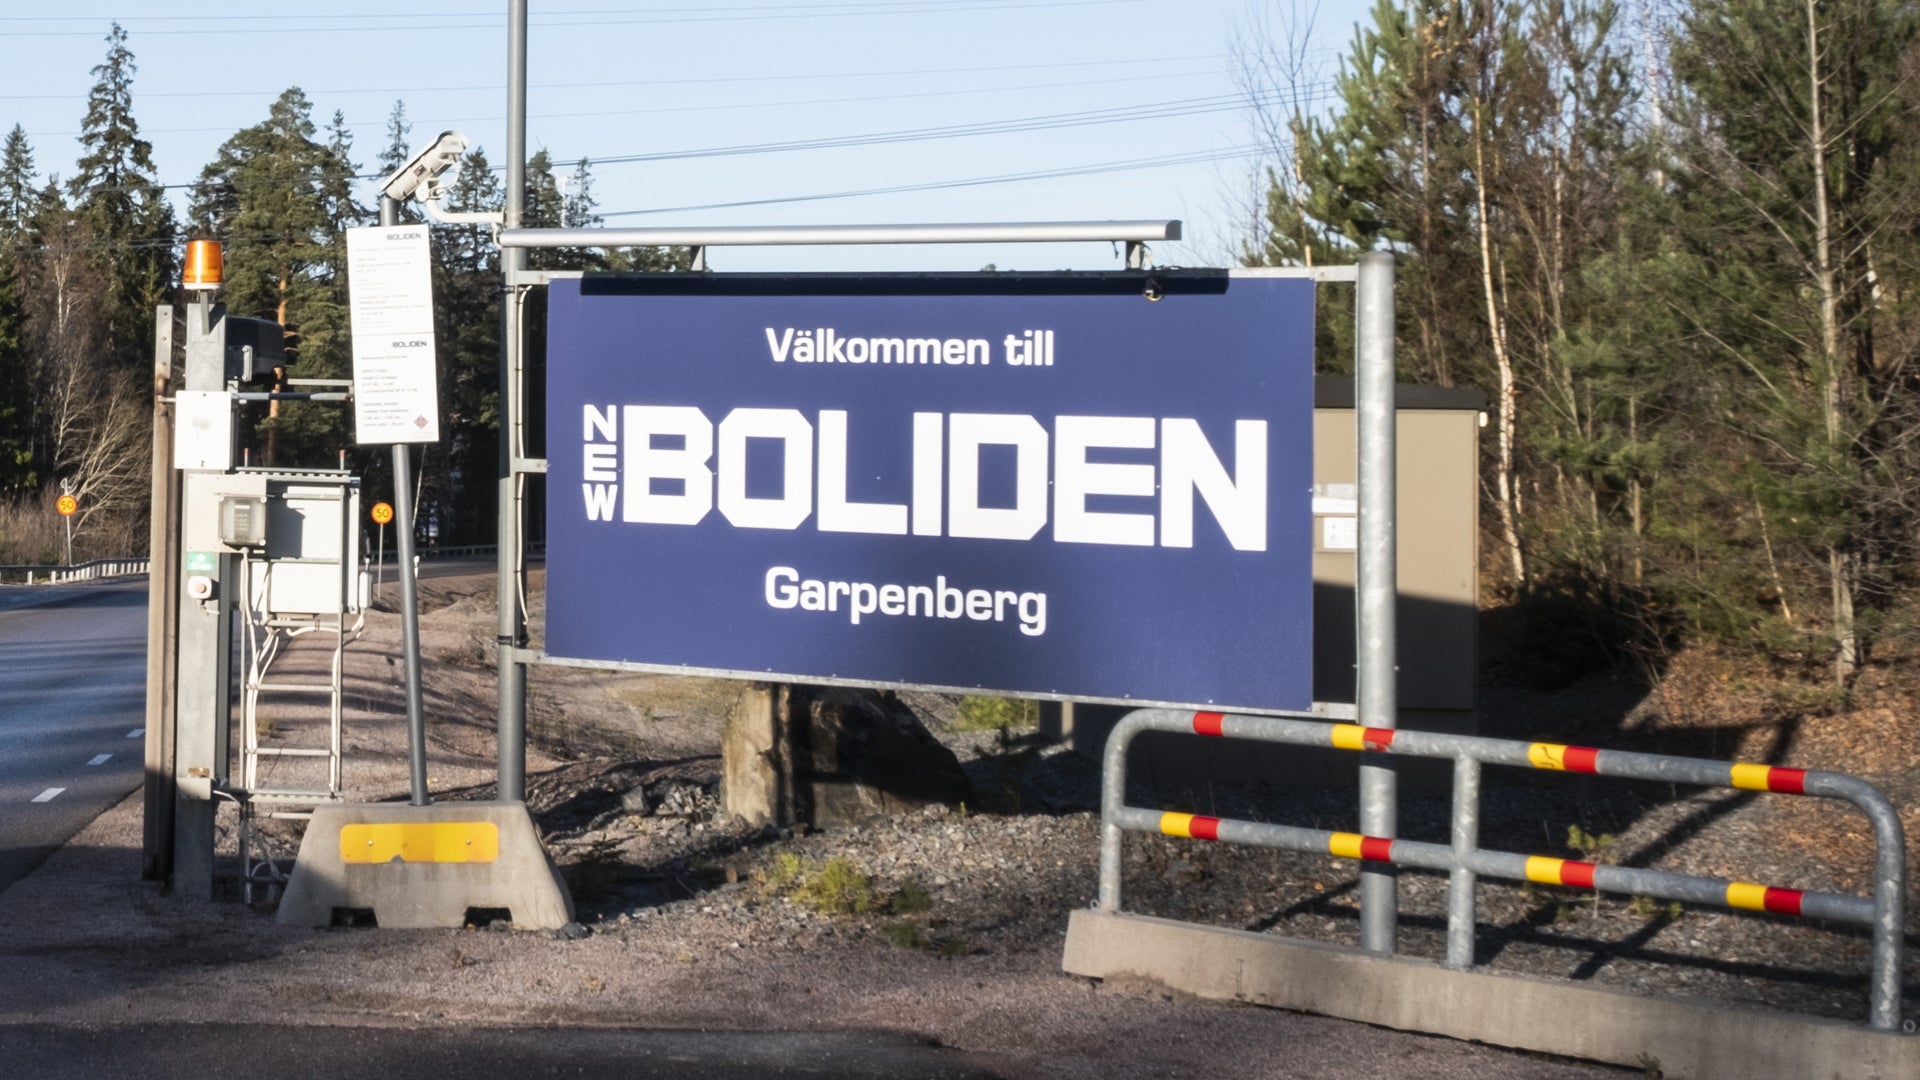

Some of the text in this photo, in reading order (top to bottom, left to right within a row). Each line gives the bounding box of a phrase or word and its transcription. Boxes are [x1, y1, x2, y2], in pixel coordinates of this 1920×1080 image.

[386, 233, 422, 241] BOLIDEN
[392, 340, 427, 348] BOLIDEN
[764, 327, 1055, 367] Välkommen till
[582, 403, 1268, 552] NEW BOLIDEN
[60, 500, 74, 510] 50
[376, 508, 389, 518] 50
[764, 565, 1048, 637] Garpenberg
